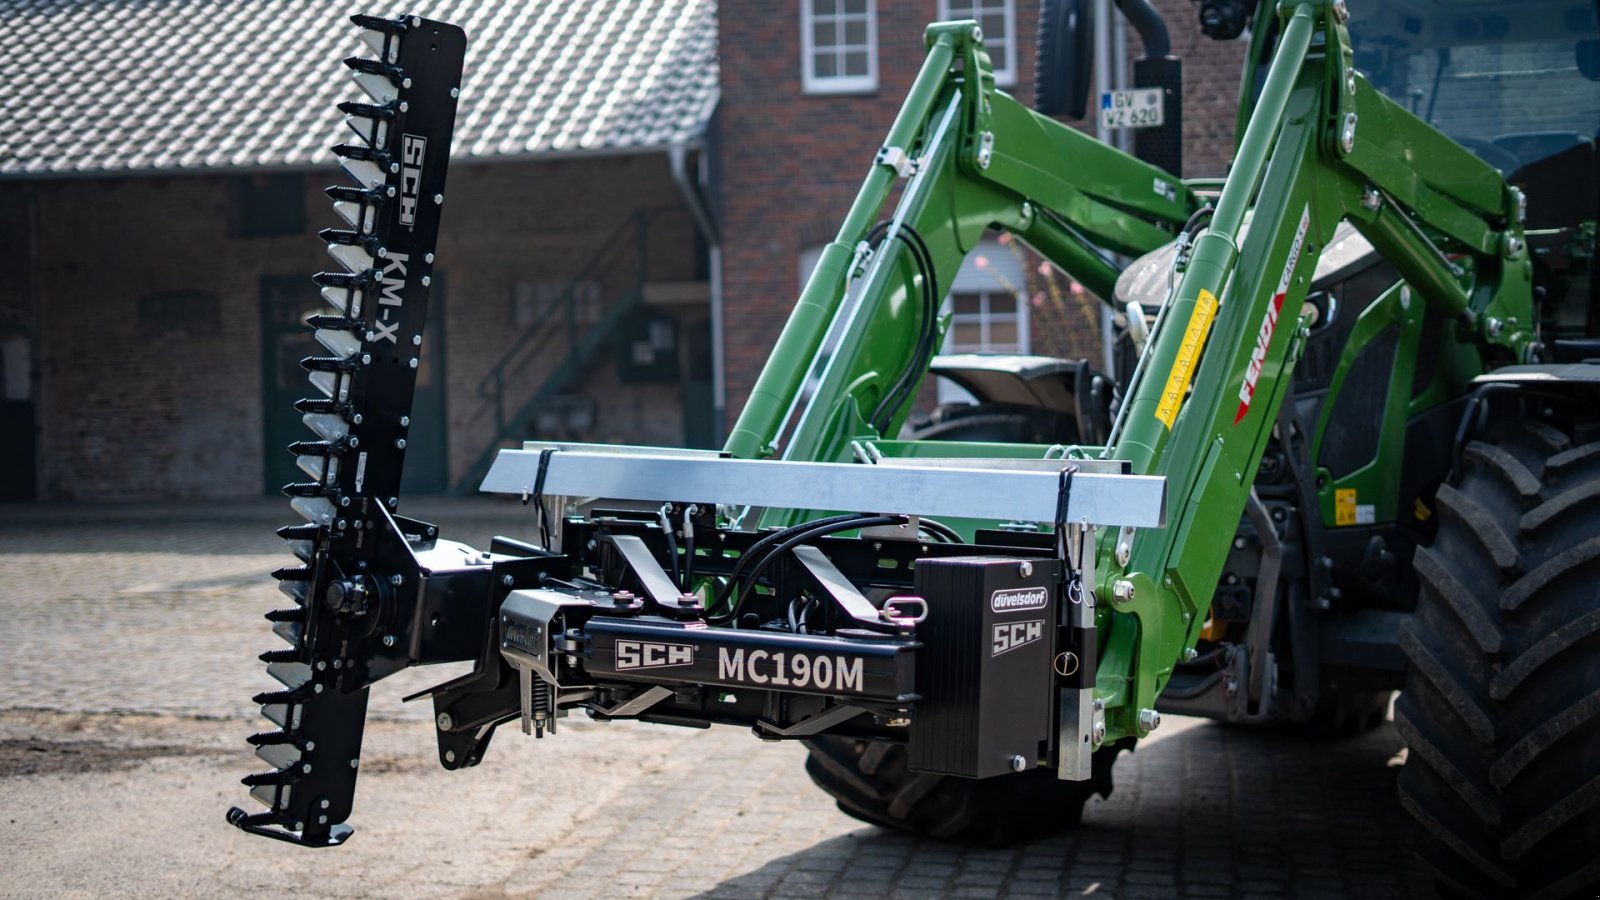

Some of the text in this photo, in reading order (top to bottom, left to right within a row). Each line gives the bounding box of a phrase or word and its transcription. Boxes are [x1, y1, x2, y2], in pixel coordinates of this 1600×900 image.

[1105, 107, 1159, 127] WZ 620
[1114, 92, 1134, 109] GV
[400, 135, 426, 225] SCH
[1282, 237, 1301, 286] CARGO
[373, 251, 410, 345] KM-X
[1238, 291, 1280, 406] FENDT
[993, 590, 1046, 608] düvelsdorf
[617, 641, 693, 669] SCH
[993, 621, 1041, 654] SCH
[718, 647, 864, 692] MC190M
